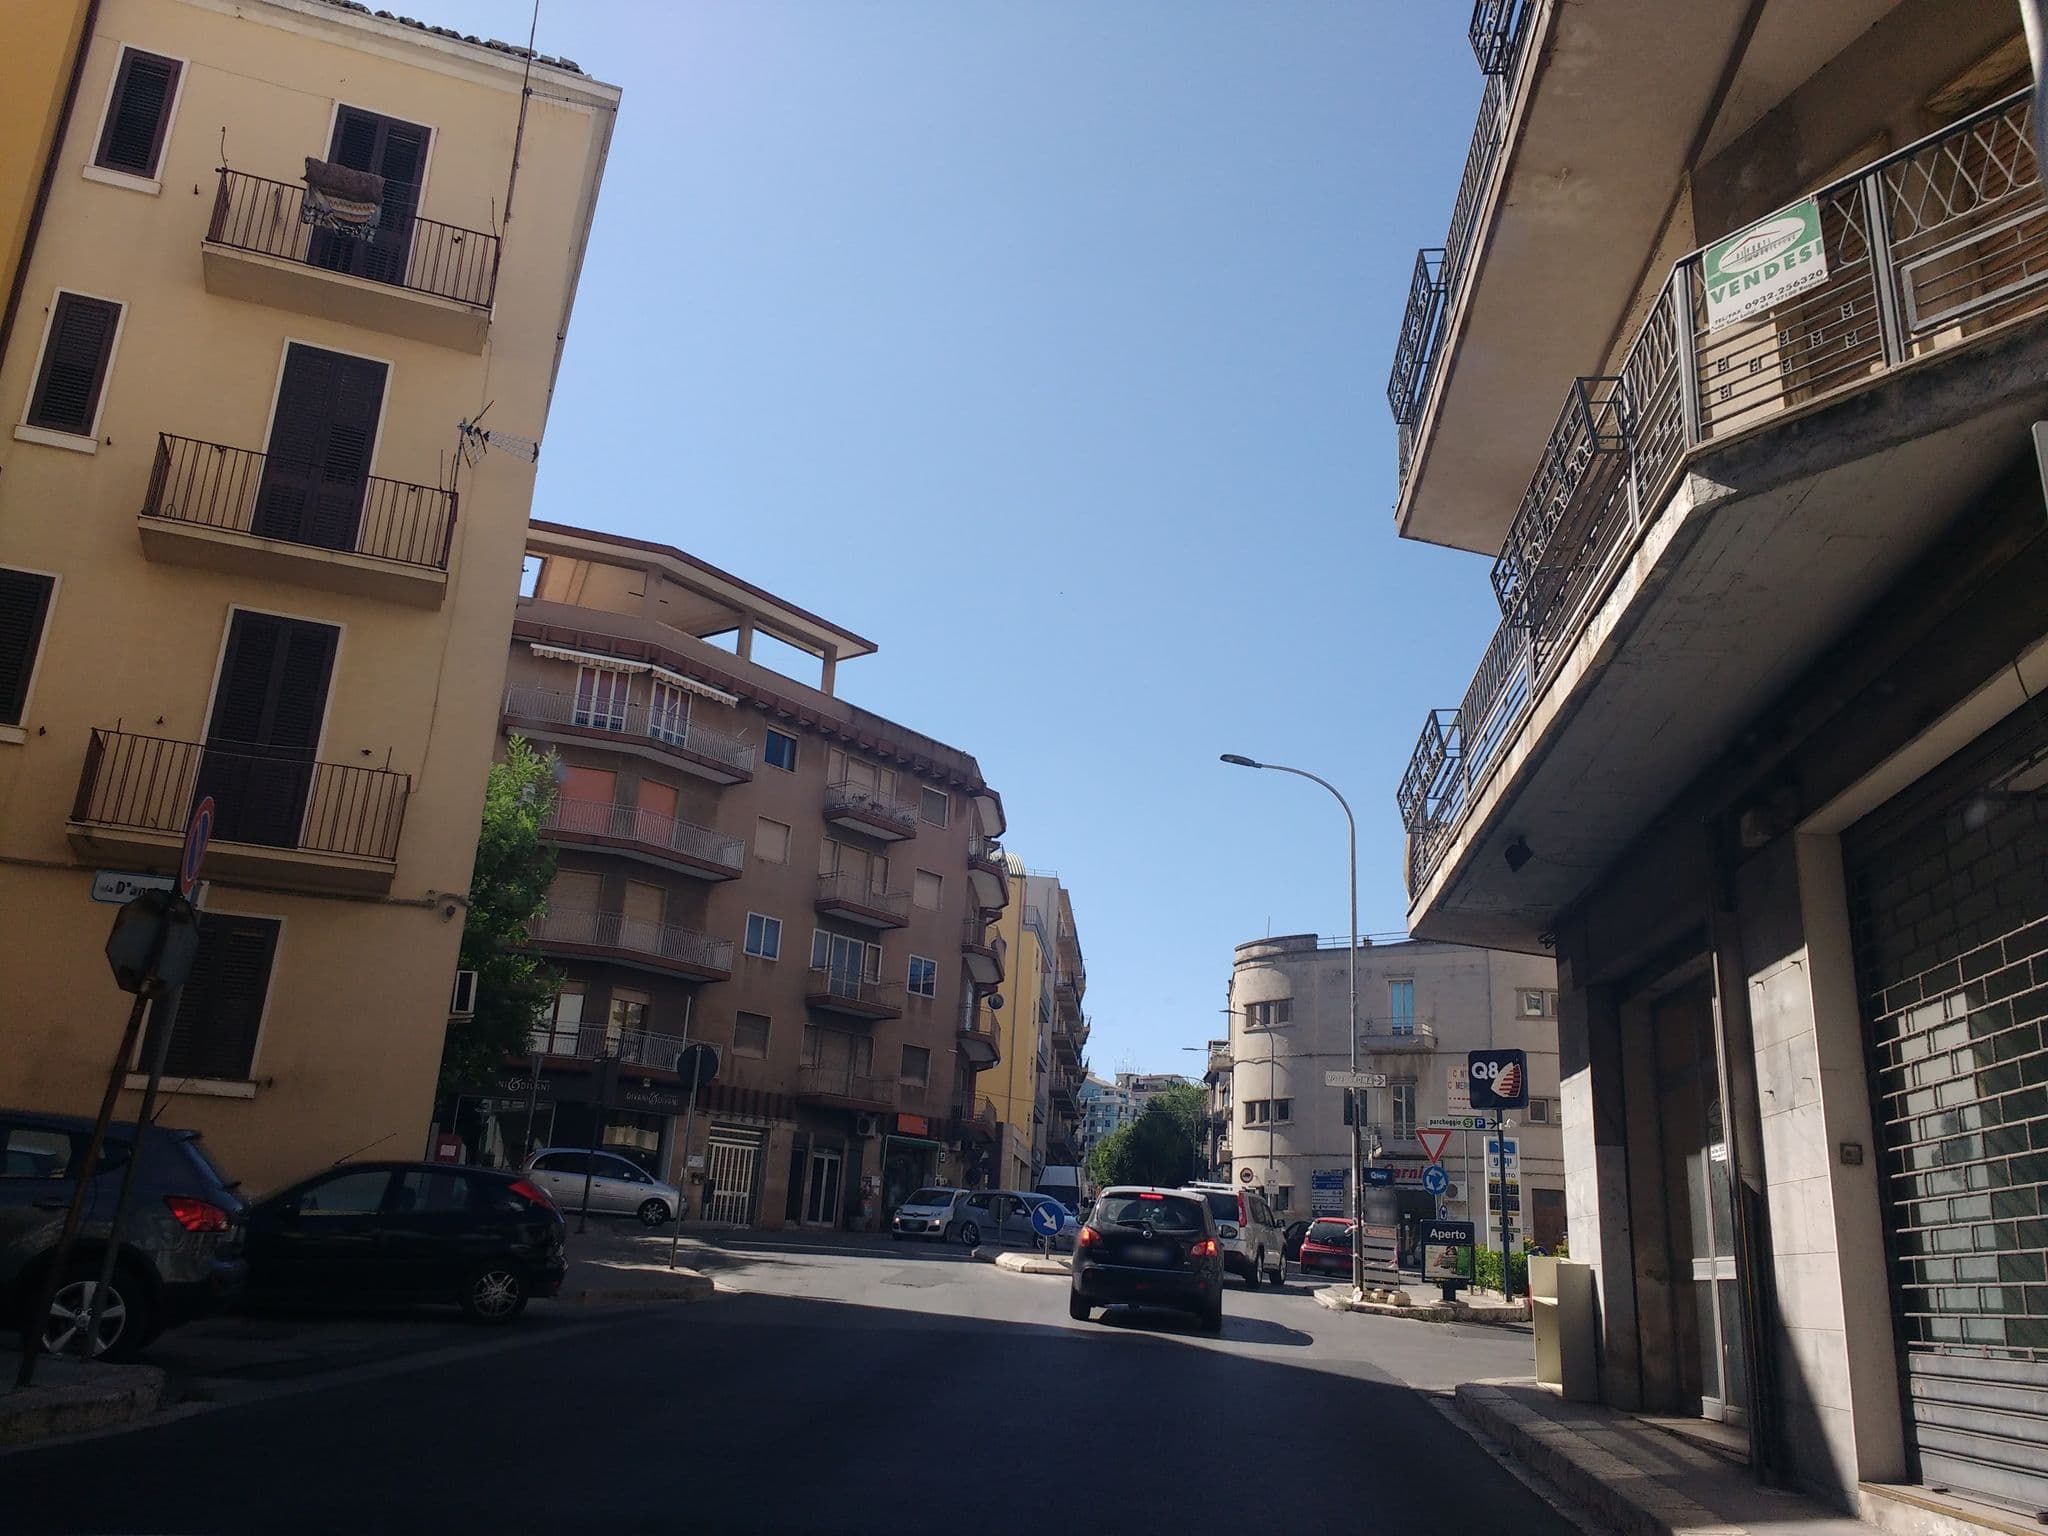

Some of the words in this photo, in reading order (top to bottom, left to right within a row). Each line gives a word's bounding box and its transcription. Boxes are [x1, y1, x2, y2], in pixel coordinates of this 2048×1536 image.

[1710, 240, 1823, 304] VENDESI
[1745, 269, 1823, 310] 0932.256320
[1471, 1061, 1499, 1080] Q8
[1429, 1118, 1462, 1127] parcheggio
[1430, 1228, 1466, 1241] Aperto
